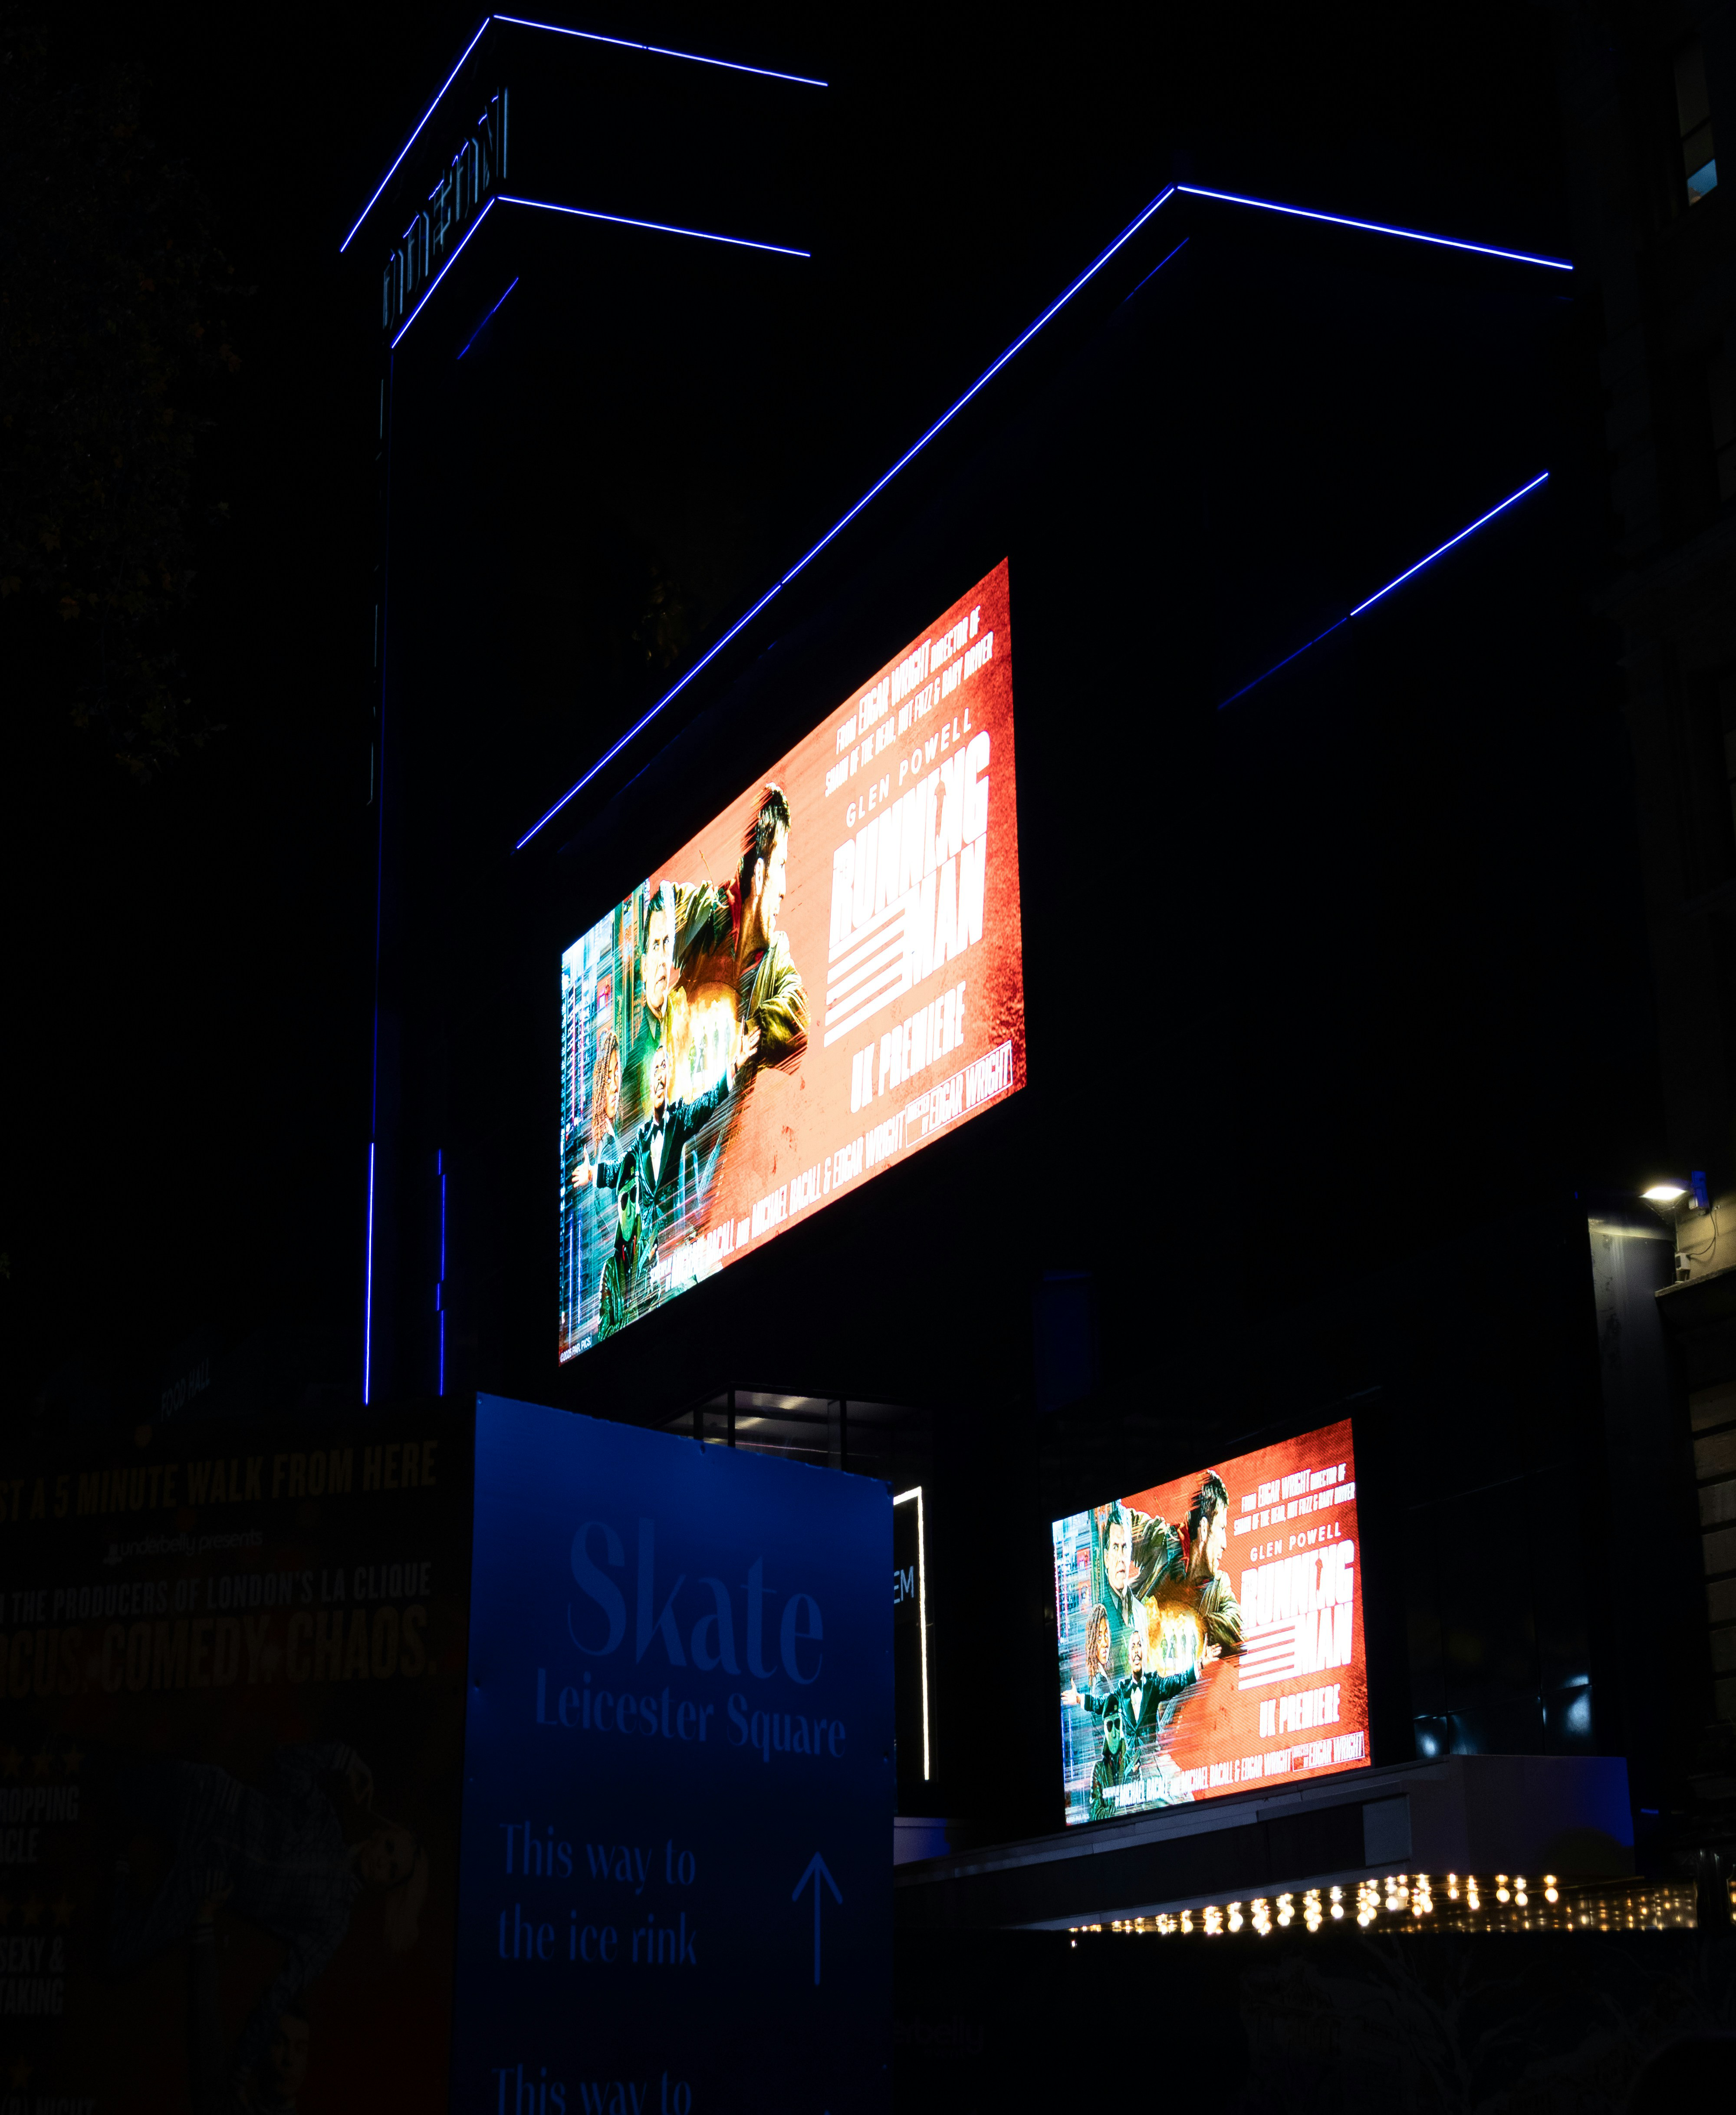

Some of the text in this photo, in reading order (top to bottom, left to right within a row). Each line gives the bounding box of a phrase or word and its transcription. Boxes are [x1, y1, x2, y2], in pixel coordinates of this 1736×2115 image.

[825, 755, 849, 797] SHAUN
[849, 745, 858, 777] OF
[861, 733, 874, 767] THE
[898, 699, 914, 737] HOT
[914, 682, 934, 722] FUZZ
[934, 677, 941, 704] &
[942, 656, 964, 698] BABY
[963, 632, 993, 680] DRIVER
[836, 605, 981, 754] FROM EDGAR WRIGHT DIRECTOR OF
[846, 707, 972, 827] GLEN POWELL
[829, 730, 990, 949] RUNNING
[903, 832, 986, 985] MAN
[850, 980, 966, 1114] UK PREMIERE
[929, 1074, 963, 1131] EDGAR
[965, 1046, 1010, 1108] WRIGHT
[707, 1218, 735, 1263] BACALL
[752, 1184, 787, 1239] MICHAEL
[789, 1163, 821, 1217] BACALL
[823, 1156, 832, 1195] &
[832, 1137, 864, 1189] EDGAR
[865, 1110, 906, 1169] WRIGHT
[161, 1358, 210, 1423] FOOD HALL
[30, 1475, 46, 1520] A
[53, 1473, 70, 1518] 5
[76, 1464, 178, 1515] MINUTE
[186, 1456, 263, 1506] WALK
[272, 1447, 353, 1499] FROM
[363, 1440, 438, 1492] HERE
[1258, 1479, 1280, 1508] EDGAR
[1281, 1469, 1311, 1499] WRIGHT
[1310, 1466, 1337, 1490] DIRECTOR
[1338, 1463, 1346, 1482] OF
[1299, 1495, 1313, 1515] FUZZ
[1334, 1482, 1355, 1504] DRIVER
[120, 1529, 263, 1557] underbelly presents
[1250, 1522, 1341, 1562] GLEN POWELL
[12, 1591, 48, 1624] THE
[53, 1581, 168, 1620] PRODUCERS
[176, 1578, 200, 1611] OF
[207, 1569, 313, 1609] LONDON'S
[320, 1567, 346, 1603] LA
[353, 1562, 431, 1601] CLIQUE
[567, 1516, 823, 1685] Skate
[1240, 1539, 1355, 1629] RUNNING
[286, 1604, 437, 1683] CHAOS.
[1295, 1601, 1353, 1676] MAN
[536, 1667, 846, 1762] Leicester Square
[1259, 1683, 1340, 1739] UK PREMIERE
[1120, 1780, 1145, 1807] MICHAEL
[1182, 1766, 1208, 1793] MICHAEL
[1210, 1761, 1234, 1789] BACALL
[1234, 1759, 1240, 1781] &
[1240, 1754, 1263, 1779] EDGAR
[1264, 1748, 1292, 1776] WRIGHT
[1309, 1740, 1332, 1767] EDGAR
[1333, 1734, 1362, 1762] WRIGHT
[0, 1827, 39, 1864] CLE
[499, 1821, 695, 1895] This way to
[49, 1935, 66, 1973] &
[498, 1903, 697, 1965] the ice rink
[491, 2062, 692, 2115] This way to
